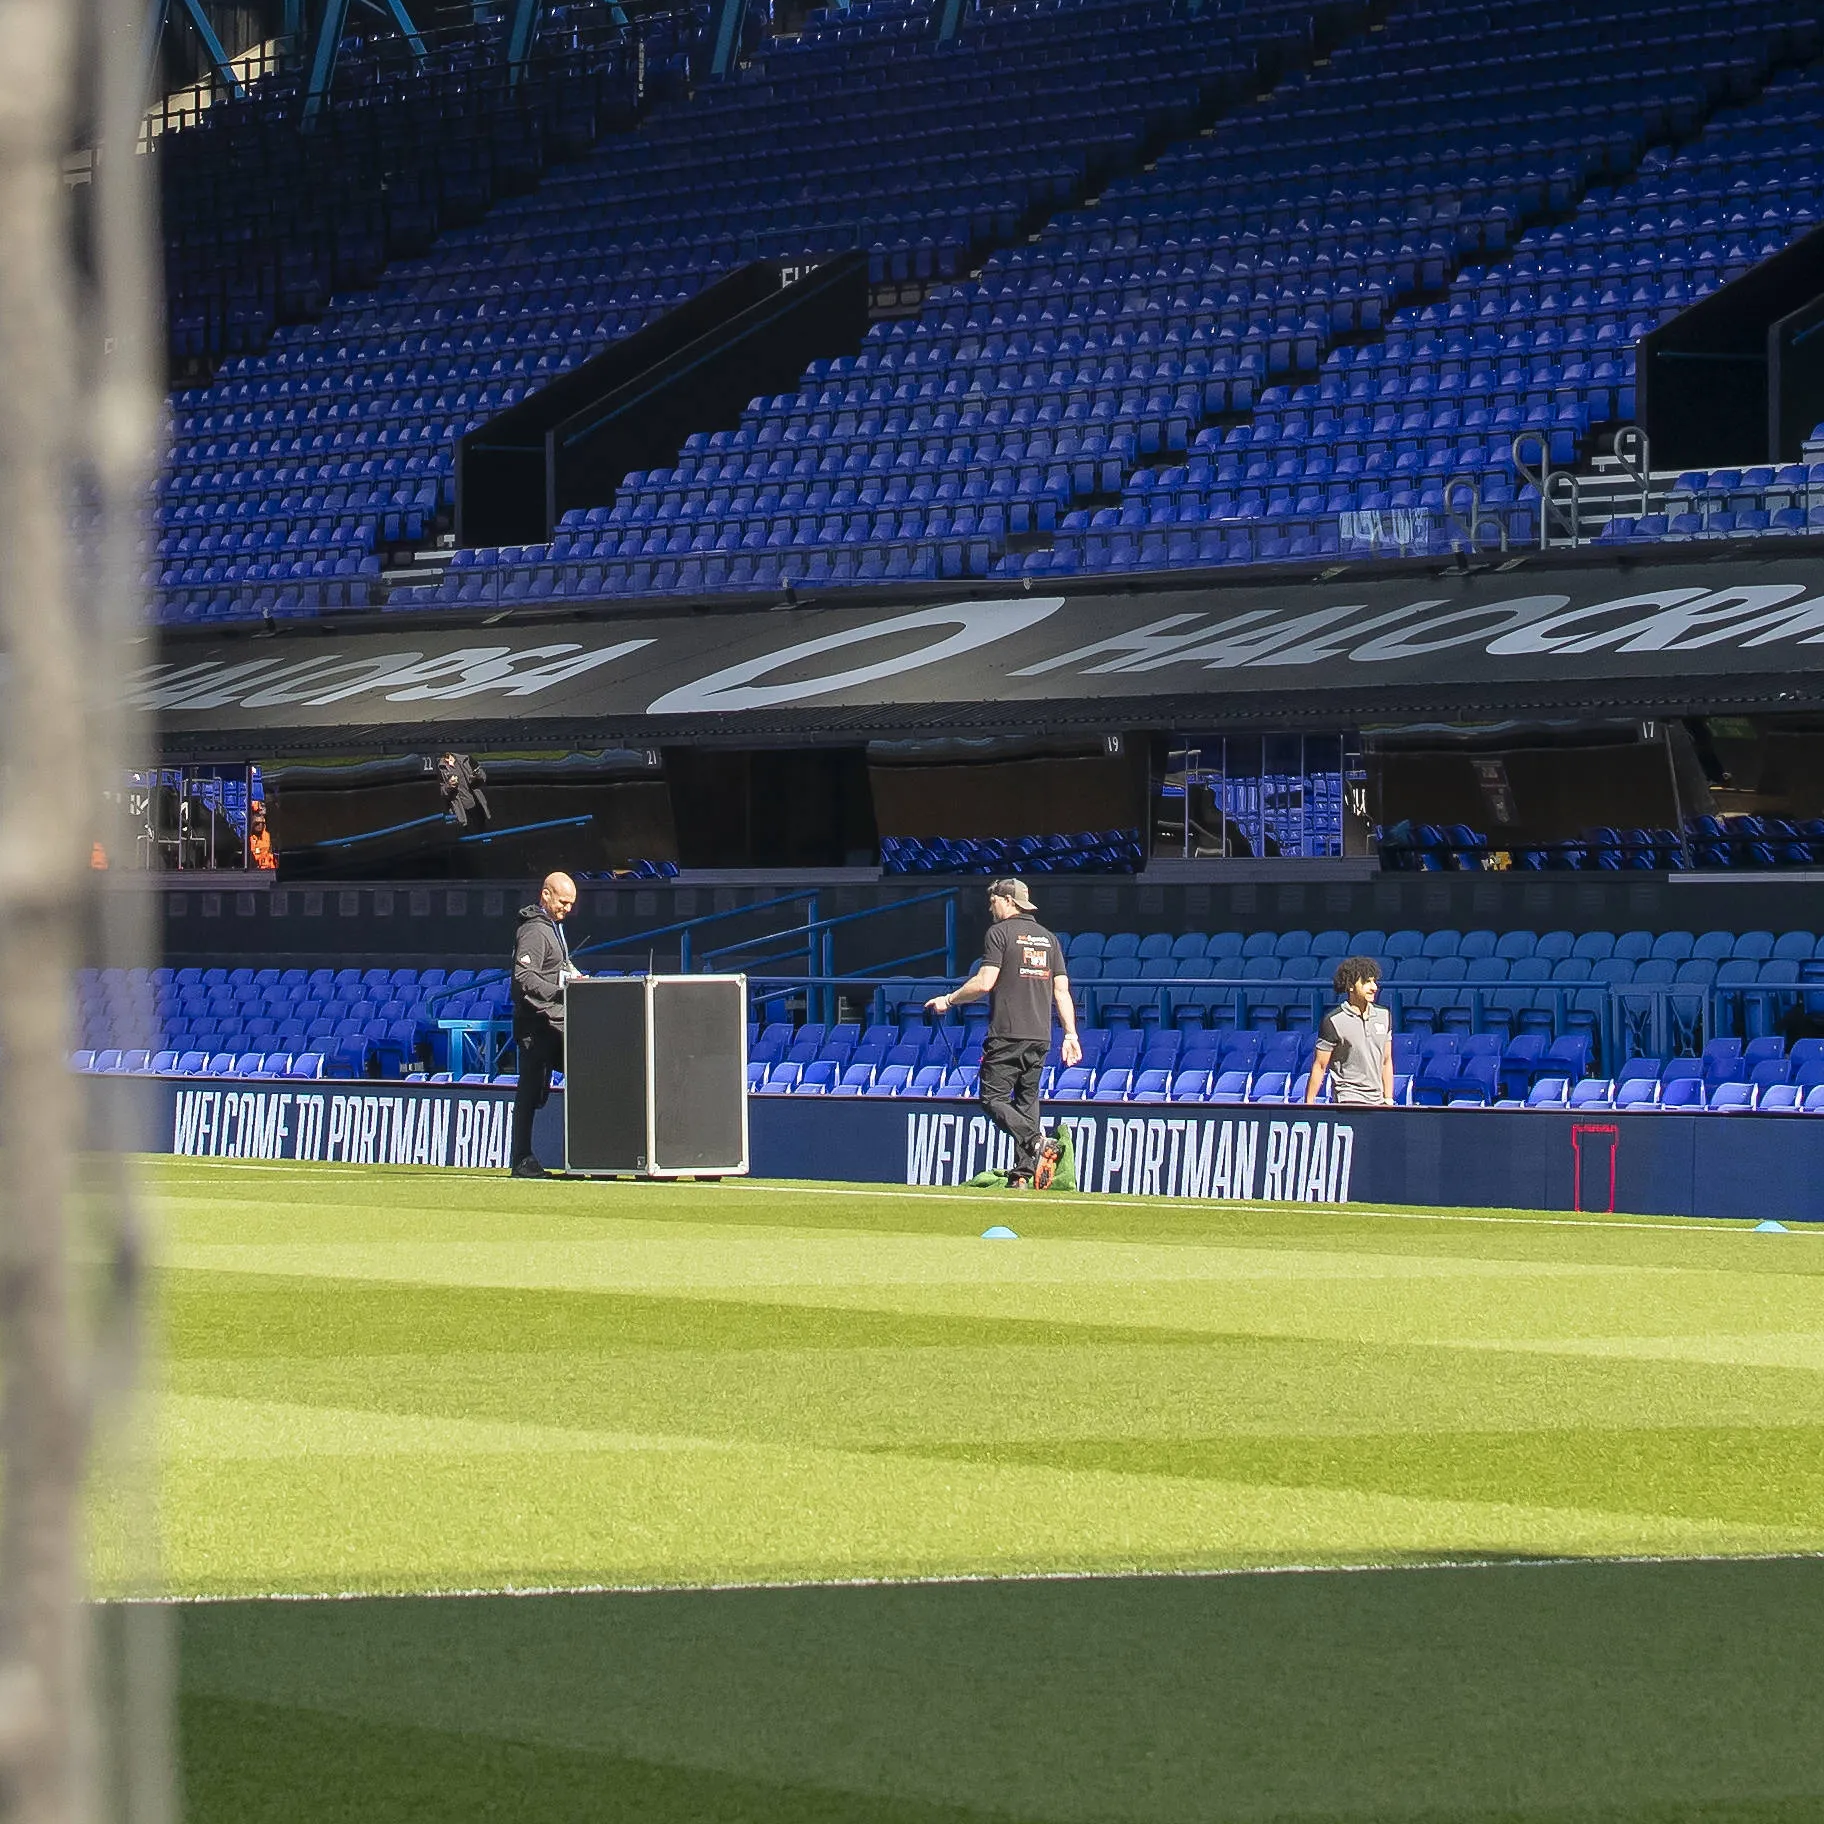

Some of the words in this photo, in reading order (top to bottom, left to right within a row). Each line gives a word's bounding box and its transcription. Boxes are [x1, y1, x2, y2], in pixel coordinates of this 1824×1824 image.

[1642, 721, 1655, 738] 17
[1107, 736, 1119, 752] 19
[423, 757, 434, 771] 22
[646, 750, 657, 765] 21
[174, 1090, 293, 1160] WELCOME
[295, 1094, 325, 1161] TO
[327, 1095, 451, 1168] PORTMAN
[906, 1112, 1054, 1187] WELCO
[1101, 1117, 1260, 1200] PORTMAN
[1264, 1120, 1355, 1203] ROAD
